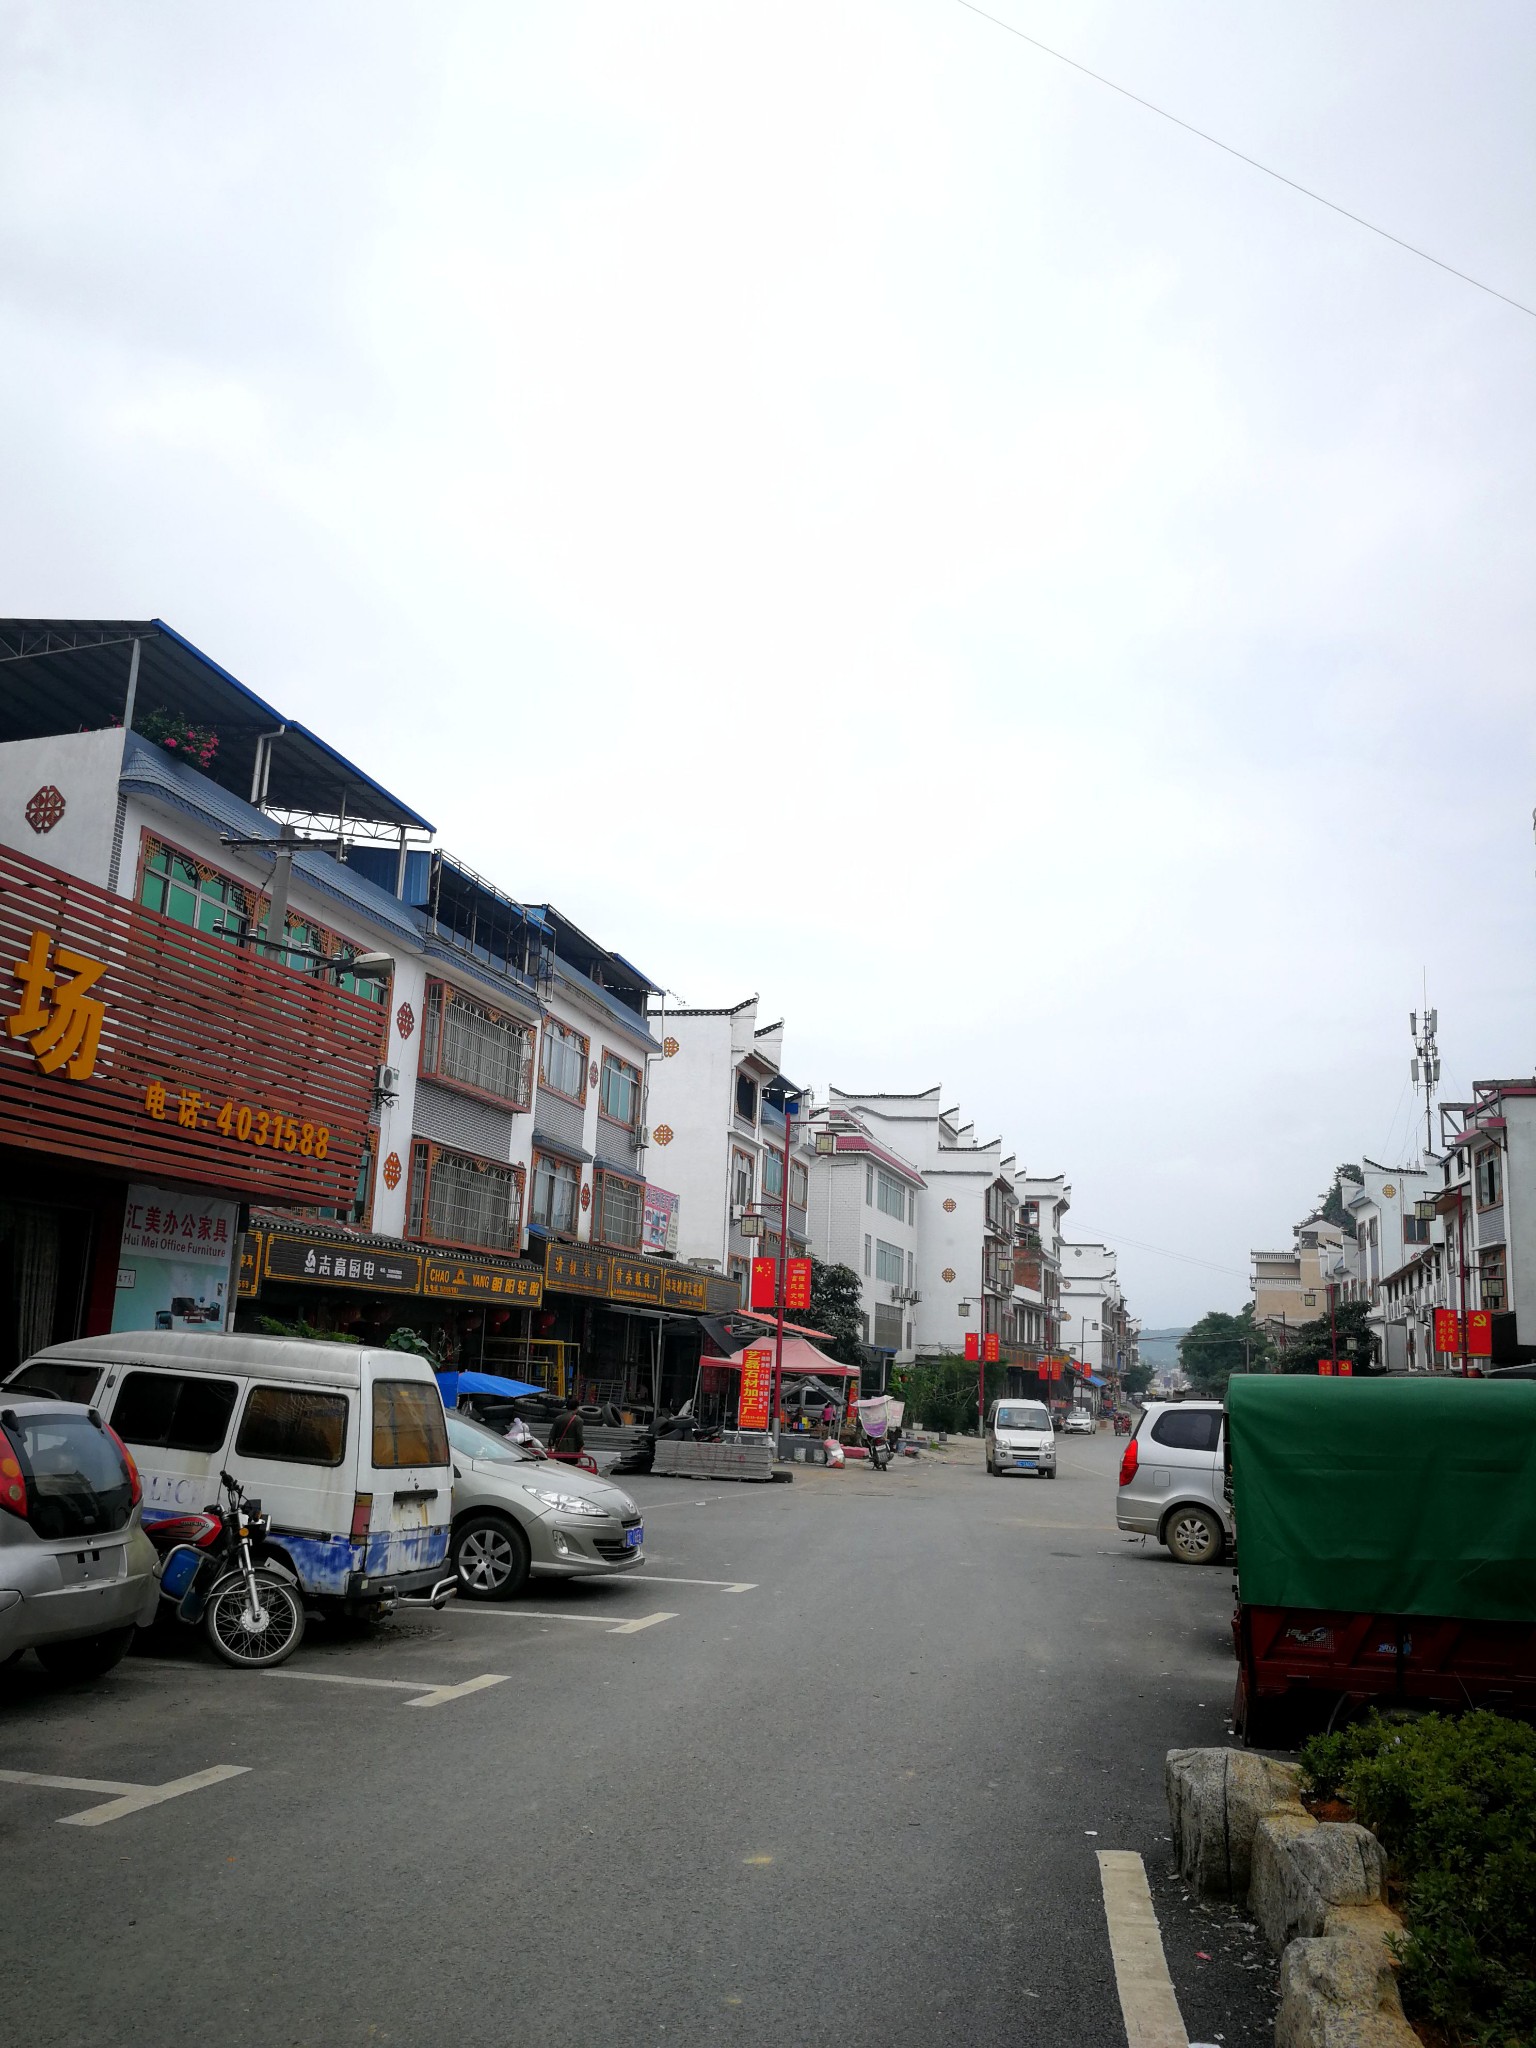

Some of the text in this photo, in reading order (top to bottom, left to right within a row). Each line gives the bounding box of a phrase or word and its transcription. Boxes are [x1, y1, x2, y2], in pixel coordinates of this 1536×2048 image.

[5, 930, 108, 1080] 场
[126, 1203, 228, 1243] 汇美办公家具
[123, 1232, 226, 1257] Hui Mei Office Furniture
[318, 1255, 375, 1280] 志高厨电
[430, 1268, 450, 1283] CHAO
[472, 1274, 490, 1288] YANG
[491, 1277, 540, 1296] 朝阳轮胎
